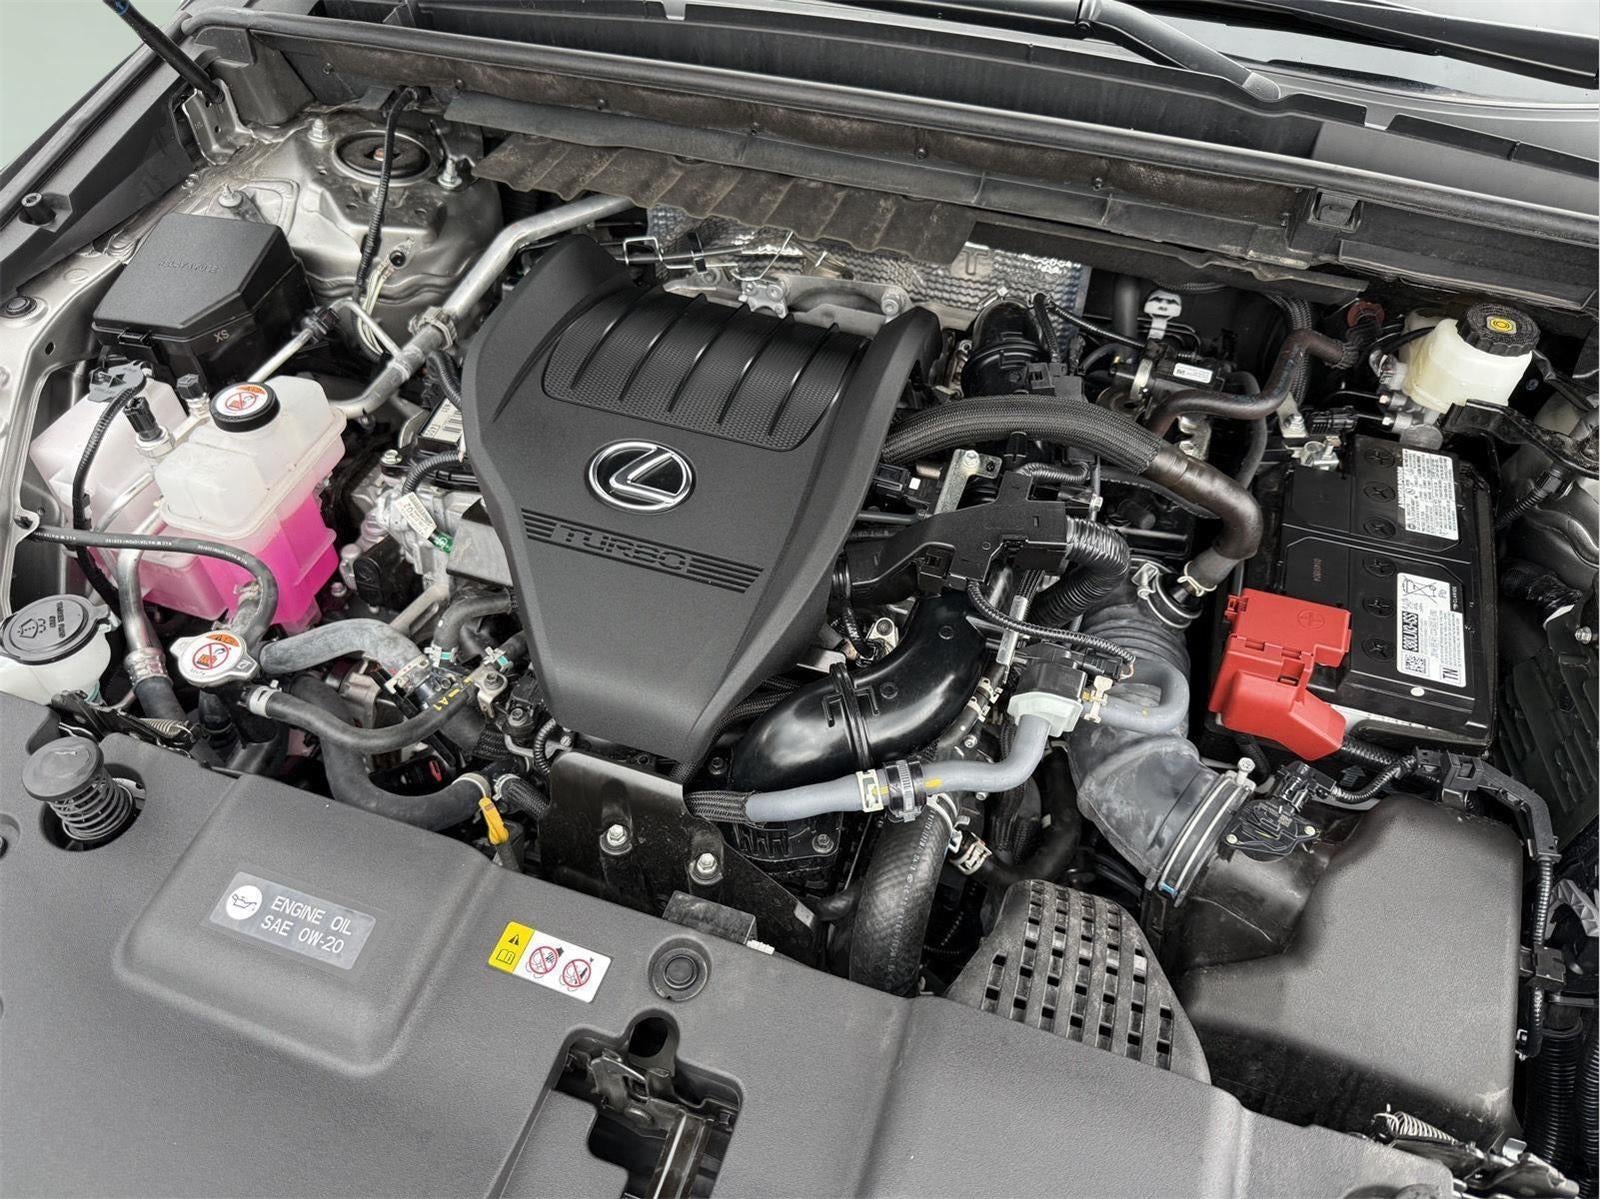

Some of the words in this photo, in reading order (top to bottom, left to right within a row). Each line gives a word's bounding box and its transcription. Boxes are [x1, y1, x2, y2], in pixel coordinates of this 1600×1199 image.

[559, 523, 687, 571] TURBO
[1443, 667, 1459, 680] TN
[261, 915, 293, 936] SAE
[298, 928, 344, 953] 0W-20
[271, 895, 326, 925] ENGINE
[331, 916, 352, 935] OIL
